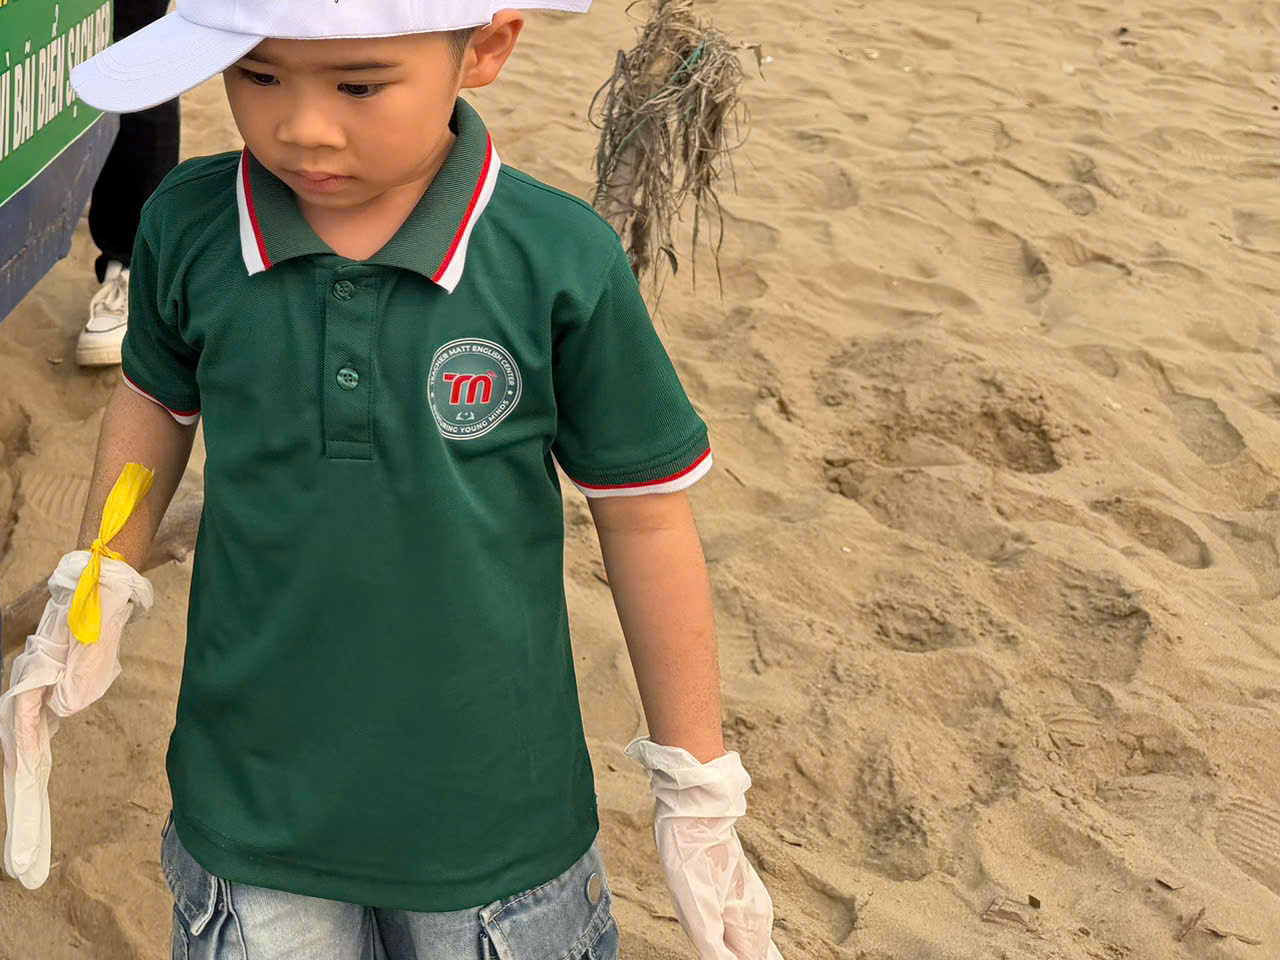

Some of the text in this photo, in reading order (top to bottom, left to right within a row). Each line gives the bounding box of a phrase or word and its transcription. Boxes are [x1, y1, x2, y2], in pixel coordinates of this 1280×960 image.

[13, 39, 37, 152] BÃI
[37, 3, 66, 132] BIỂN
[449, 345, 471, 356] MATT
[472, 345, 503, 361] ENGLISH
[501, 359, 516, 386] CENTER
[460, 420, 488, 433] YOUNG
[488, 400, 510, 423] MINDS
